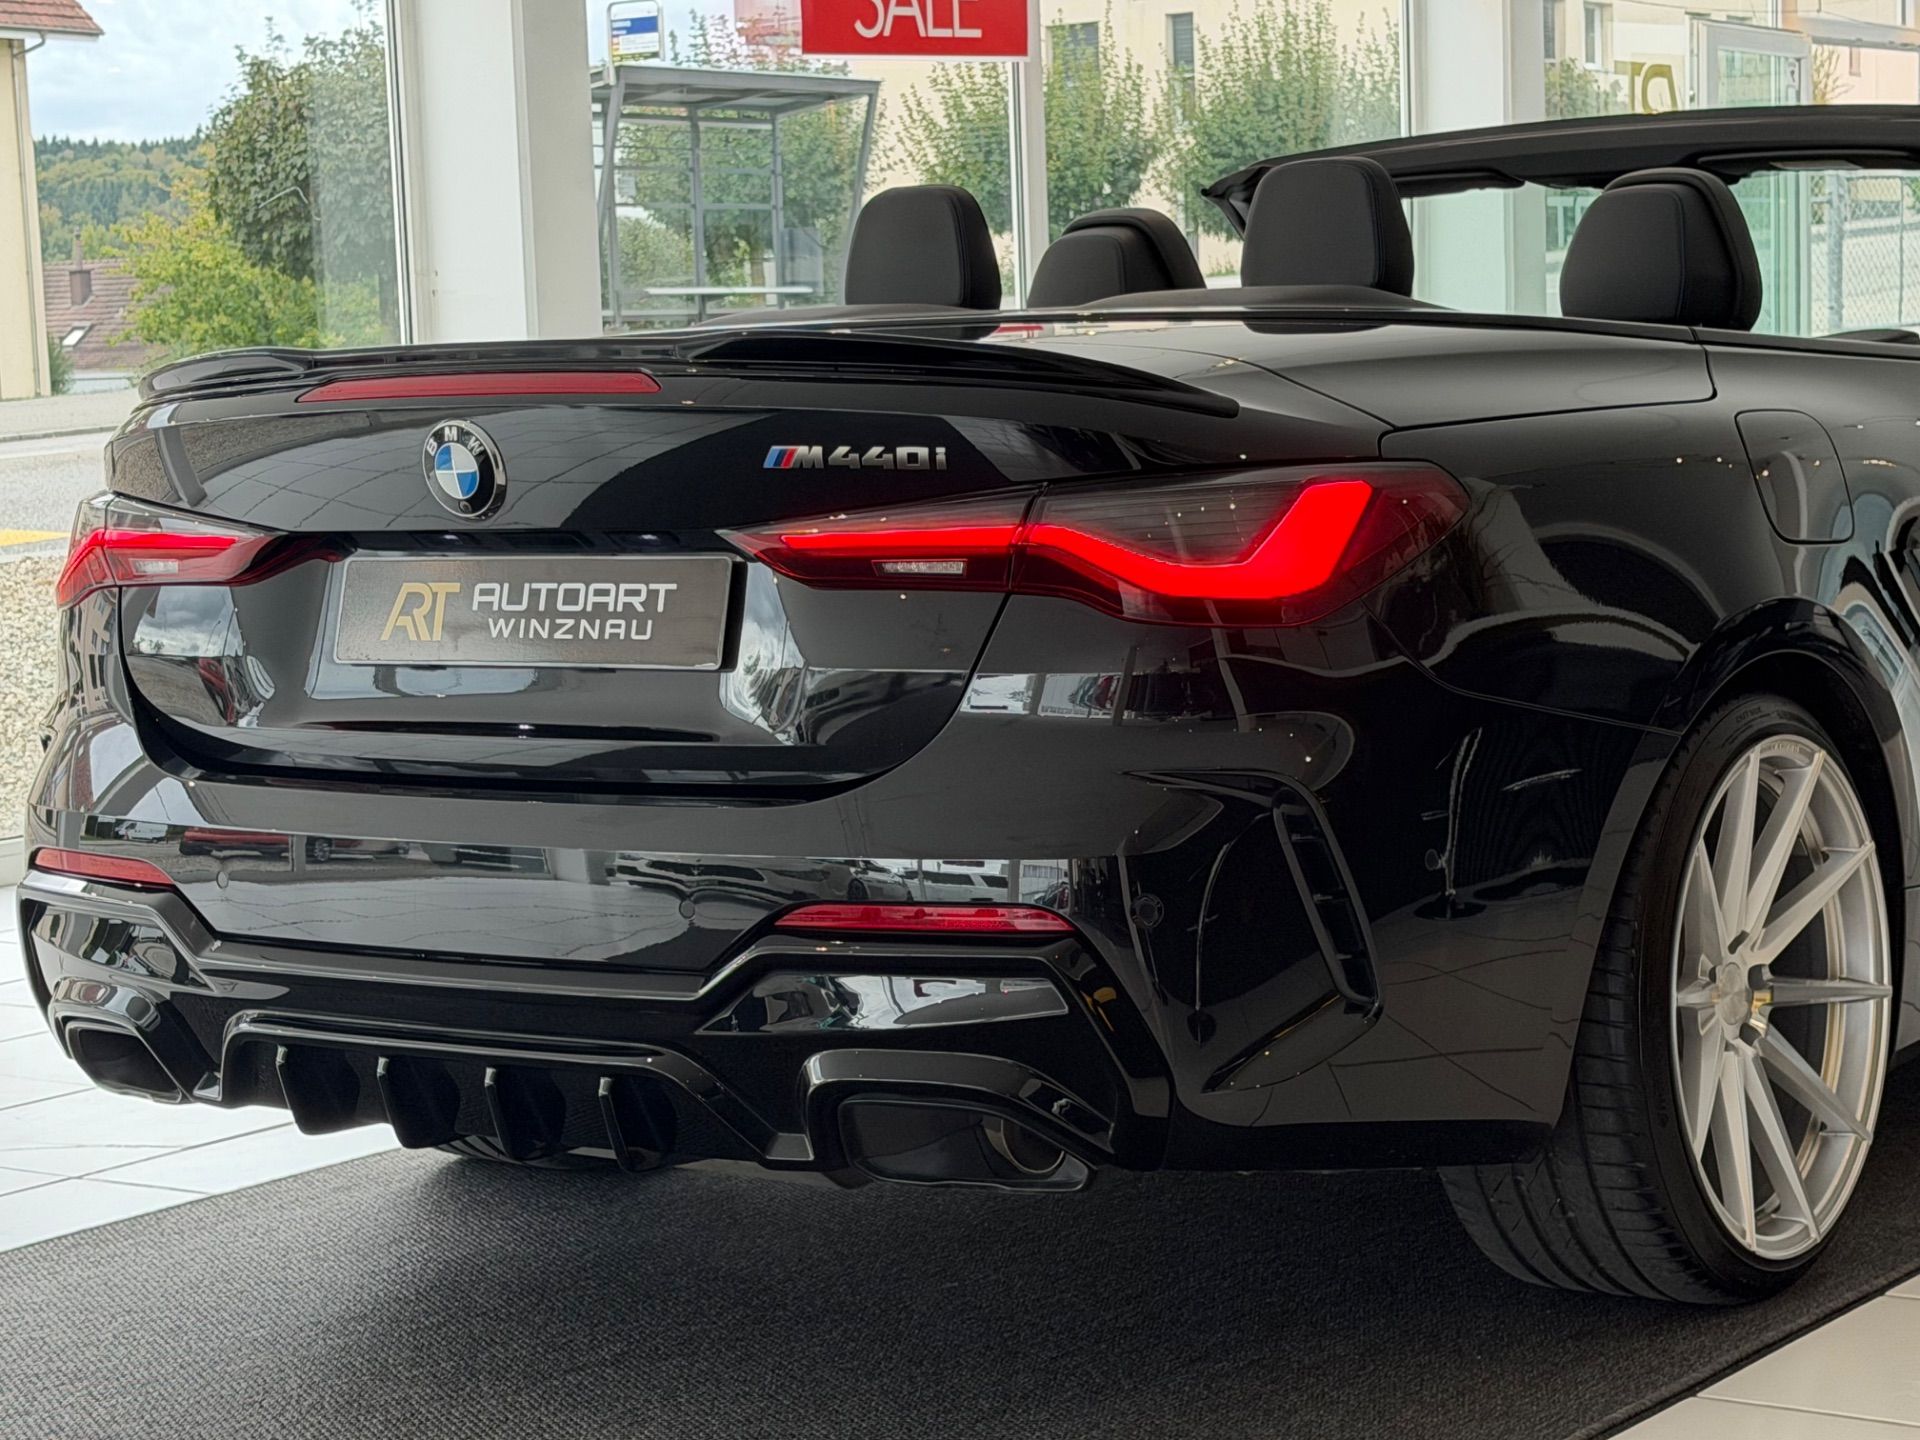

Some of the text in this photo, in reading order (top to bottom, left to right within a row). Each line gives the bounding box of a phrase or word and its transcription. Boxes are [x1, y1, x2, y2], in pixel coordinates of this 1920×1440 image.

[427, 426, 485, 456] BMW
[763, 445, 947, 470] M440i
[472, 582, 677, 612] AUTOART
[488, 618, 652, 640] WINZNAU
